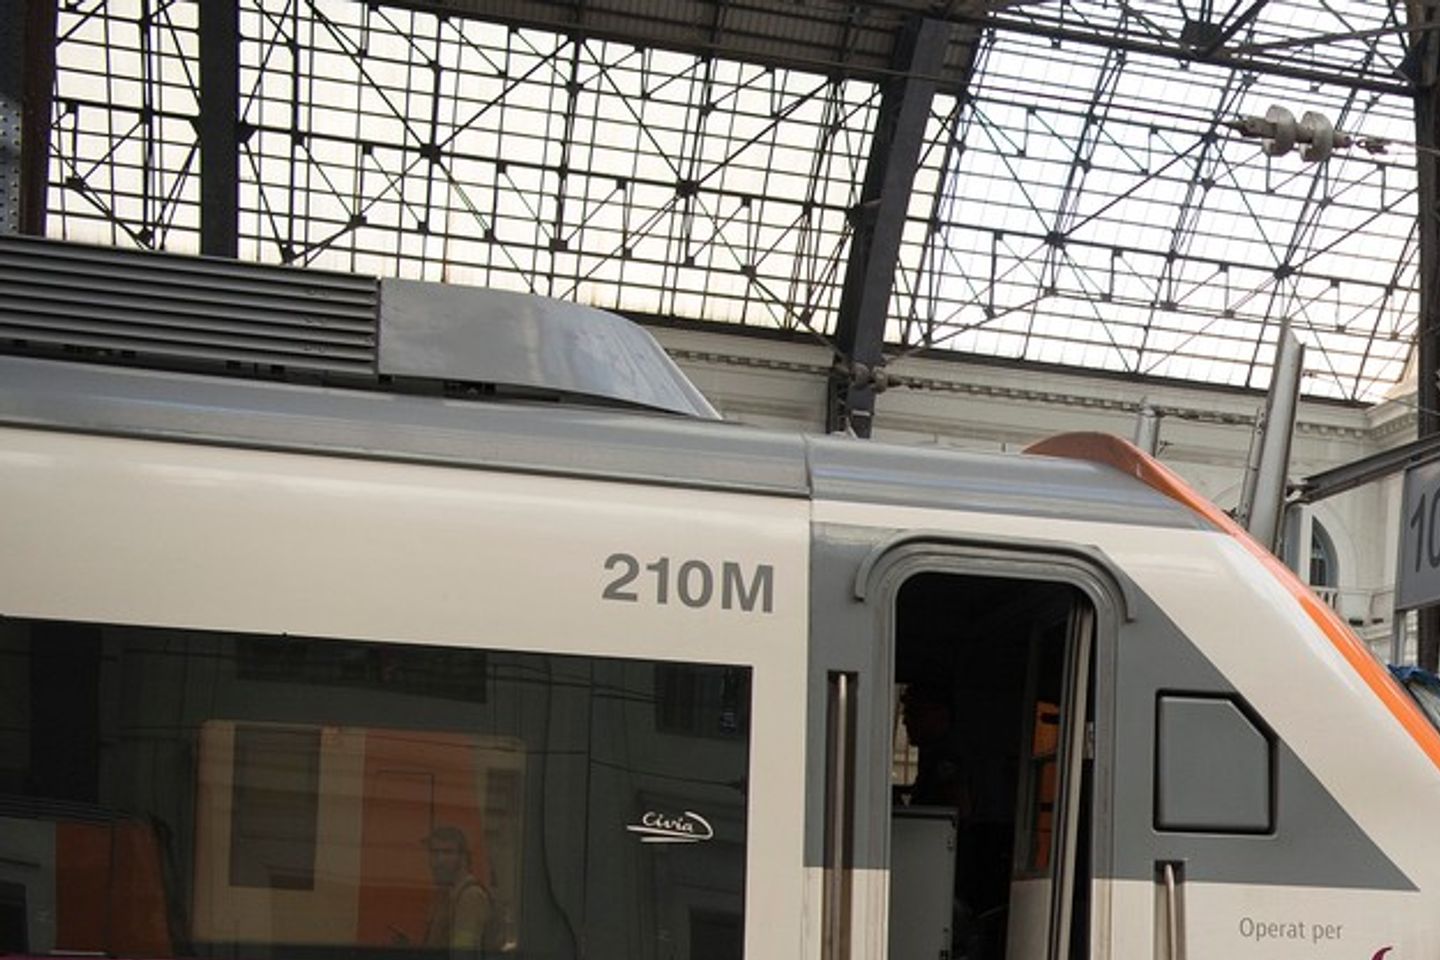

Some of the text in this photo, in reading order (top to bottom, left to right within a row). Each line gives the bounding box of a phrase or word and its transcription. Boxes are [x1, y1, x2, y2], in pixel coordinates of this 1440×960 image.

[601, 553, 774, 613] 210M
[641, 810, 704, 835] Civia
[1239, 917, 1343, 944] Operat per
